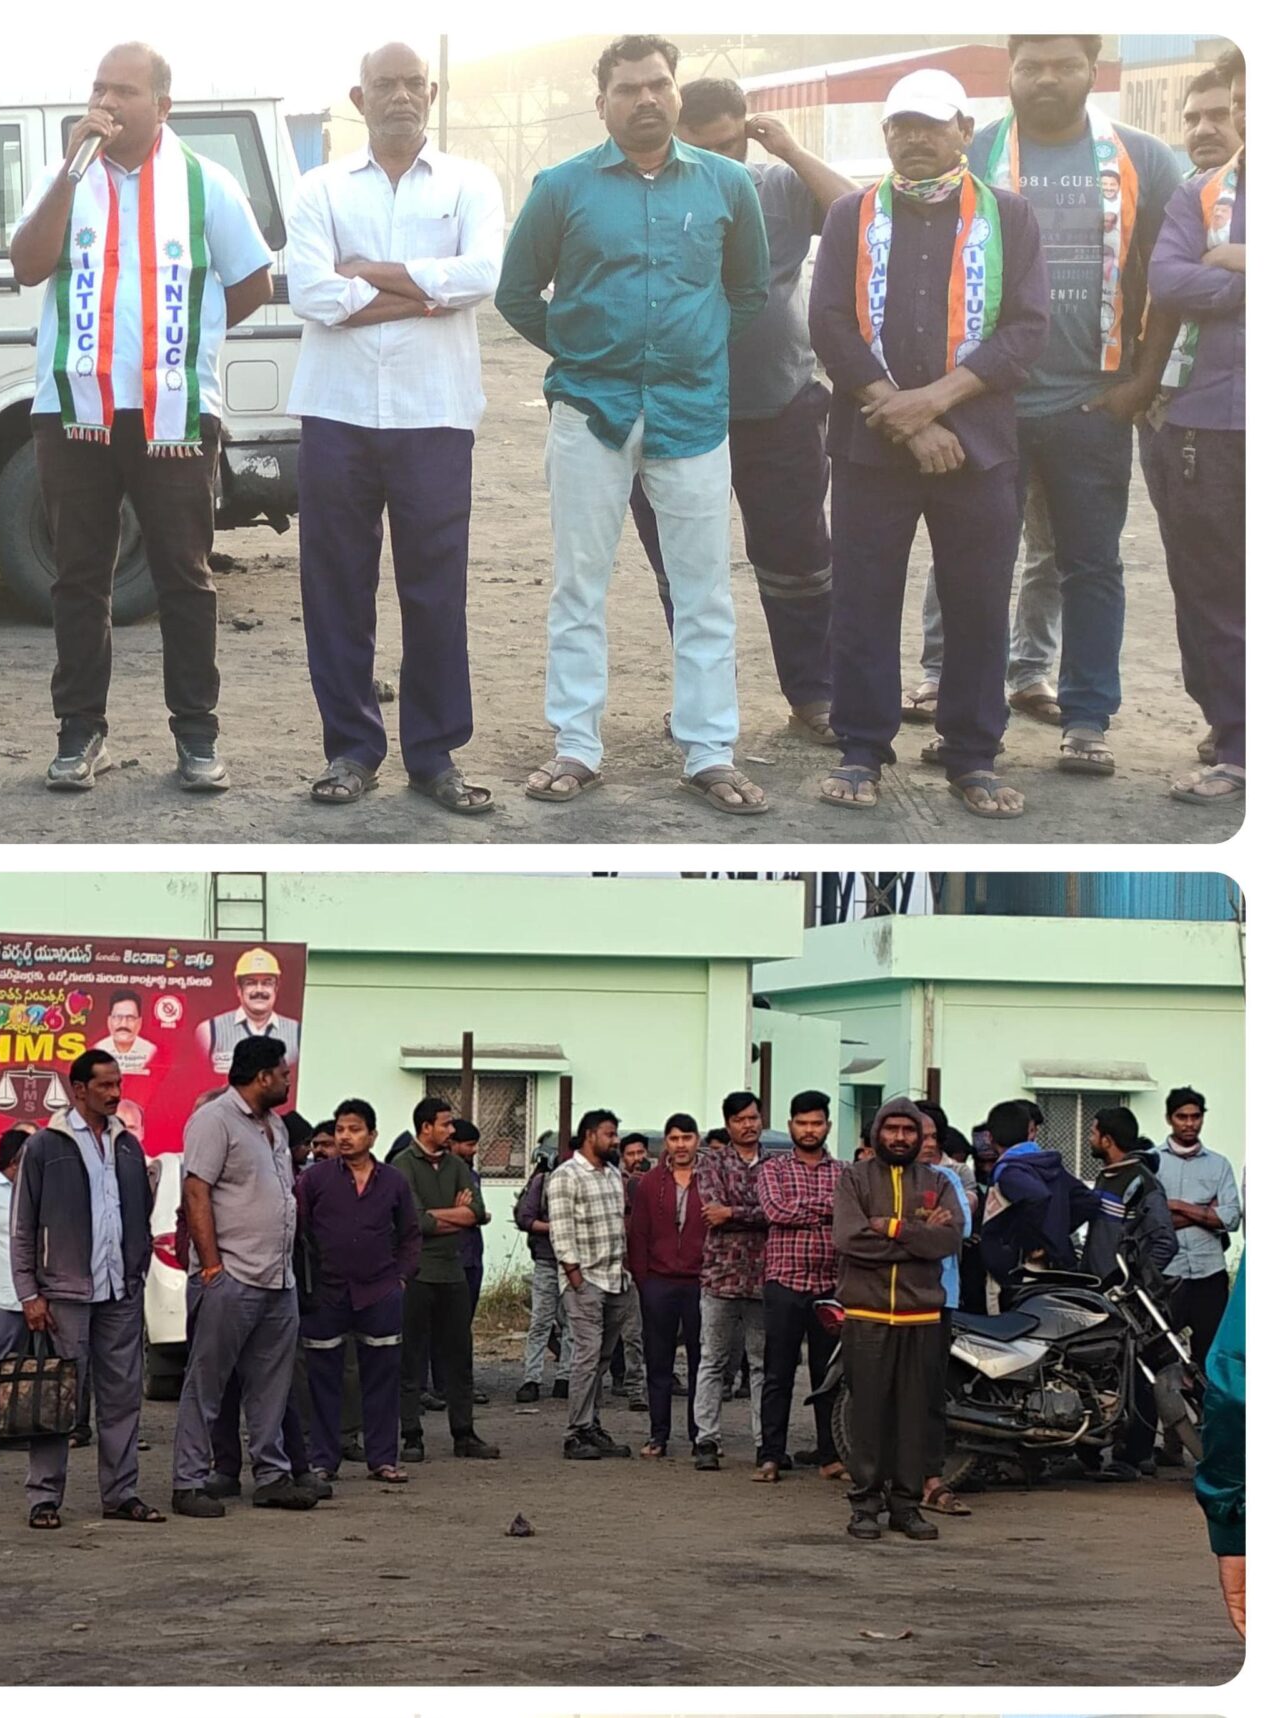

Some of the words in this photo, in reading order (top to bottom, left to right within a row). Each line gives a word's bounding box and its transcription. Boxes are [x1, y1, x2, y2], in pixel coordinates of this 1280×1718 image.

[1124, 77, 1168, 136] DRIVE
[1018, 175, 1102, 188] 981-GUE
[1056, 193, 1087, 206] USA
[76, 252, 95, 351] INTUC
[165, 264, 183, 366] INTUC
[870, 248, 887, 327] INTUC
[966, 250, 984, 331] INTUC
[1050, 288, 1088, 300] ENTIC
[23, 1079, 38, 1112] HMS
